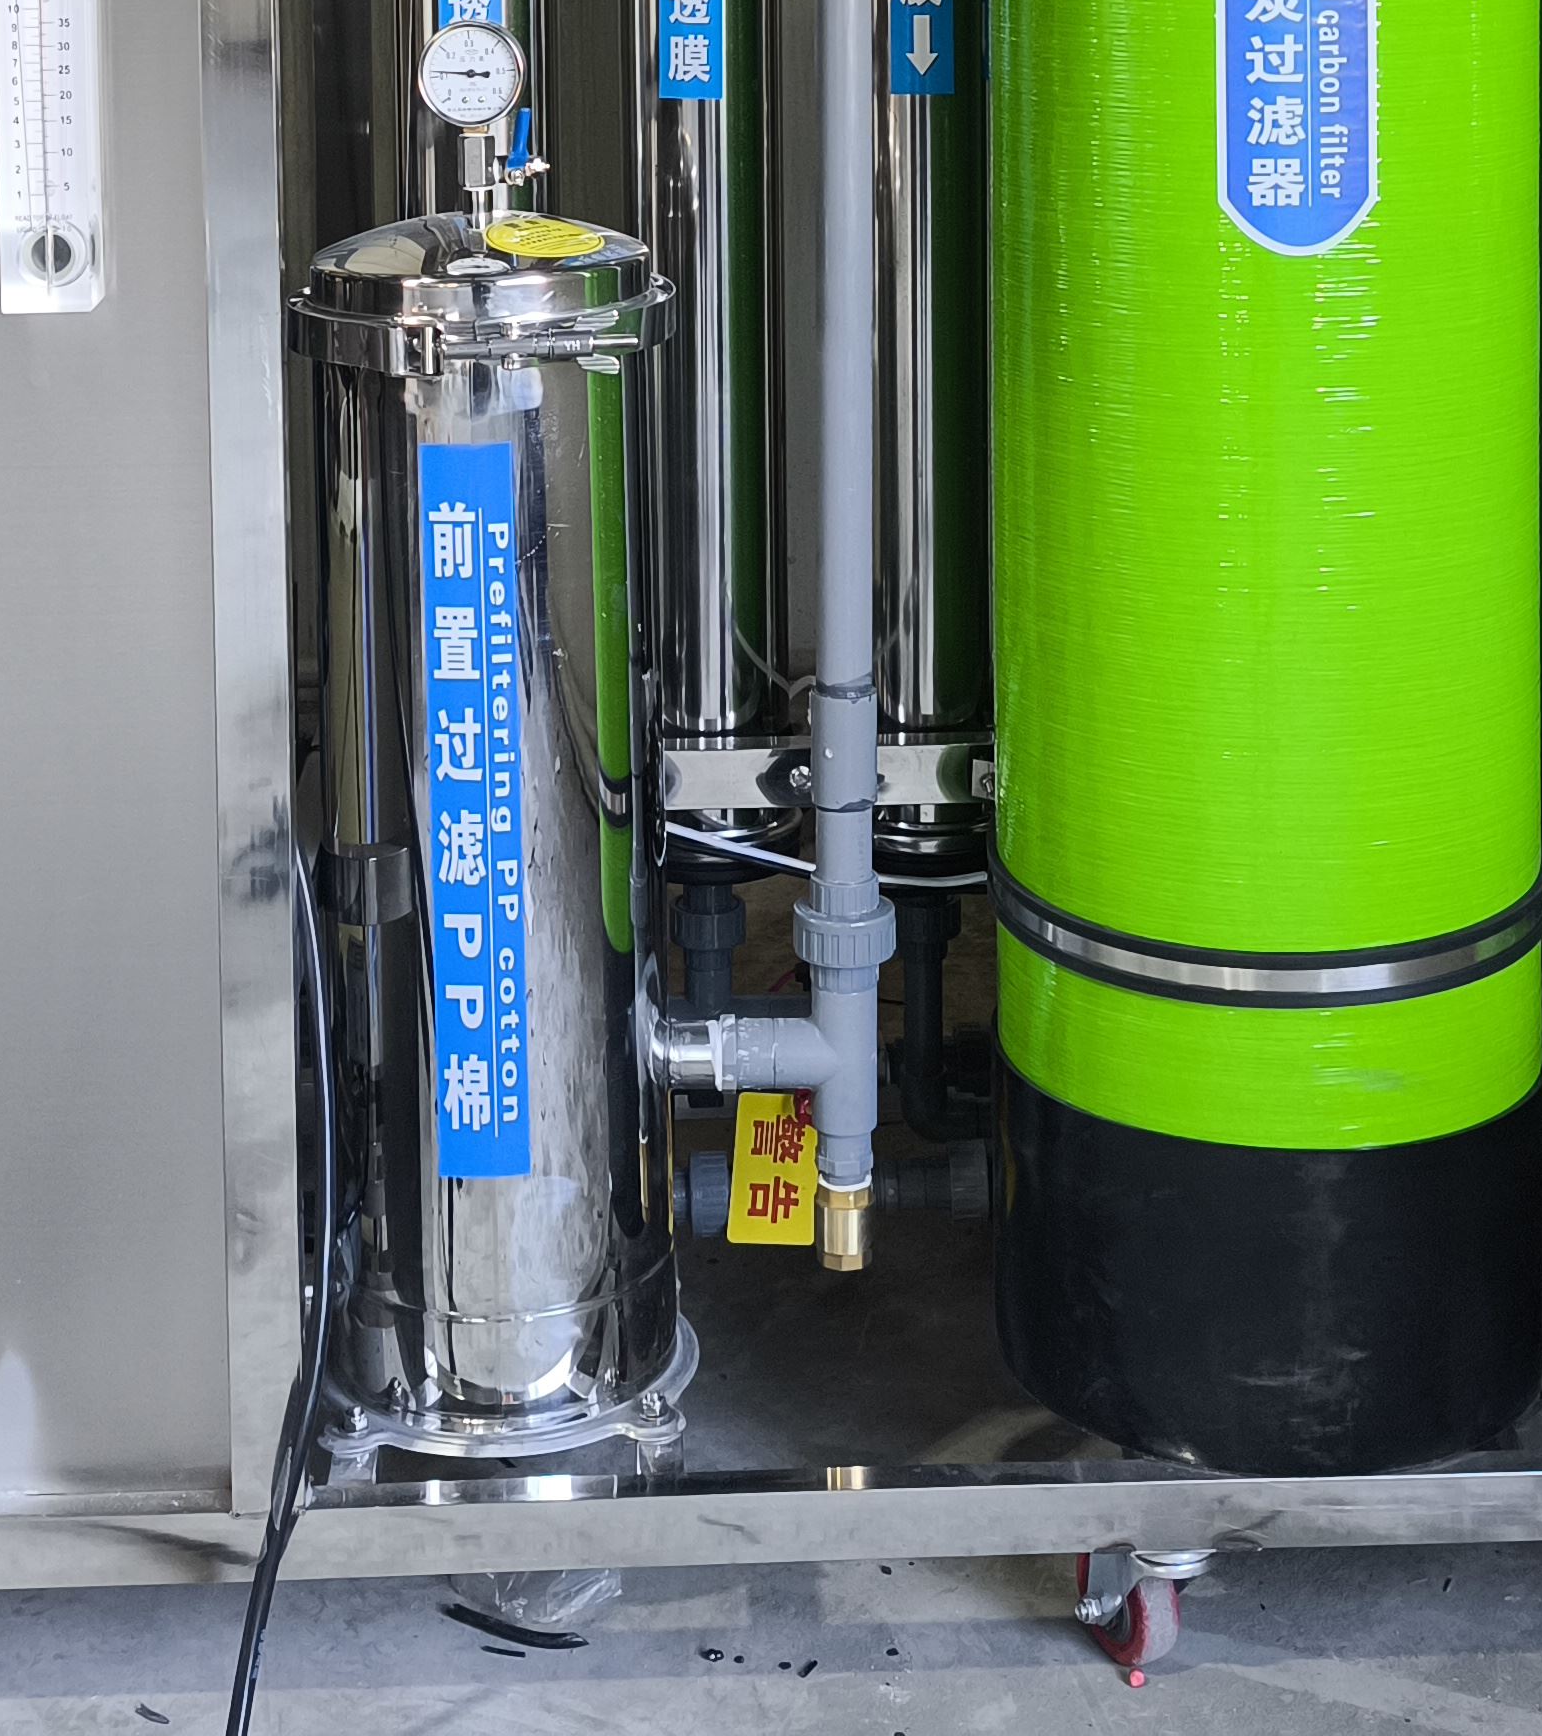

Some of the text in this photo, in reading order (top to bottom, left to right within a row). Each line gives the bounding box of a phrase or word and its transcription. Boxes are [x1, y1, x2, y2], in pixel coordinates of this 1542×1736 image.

[8, 4, 19, 14] 10
[58, 18, 70, 28] 35
[57, 42, 70, 51] 30
[464, 39, 474, 47] 0.3
[445, 52, 456, 60] 0.2
[484, 47, 495, 55] 0.4
[1317, 10, 1348, 113] carbon
[58, 65, 71, 75] 25
[495, 67, 506, 75] 0.5
[59, 90, 73, 100] 20
[492, 87, 503, 95] 0.6
[60, 115, 72, 125] 15
[61, 148, 73, 157] 10
[1319, 124, 1349, 198] filter
[563, 339, 581, 352] YH
[428, 501, 494, 1133] 前置过滤PP棉
[487, 521, 522, 1124] Prefiltering PP cotton
